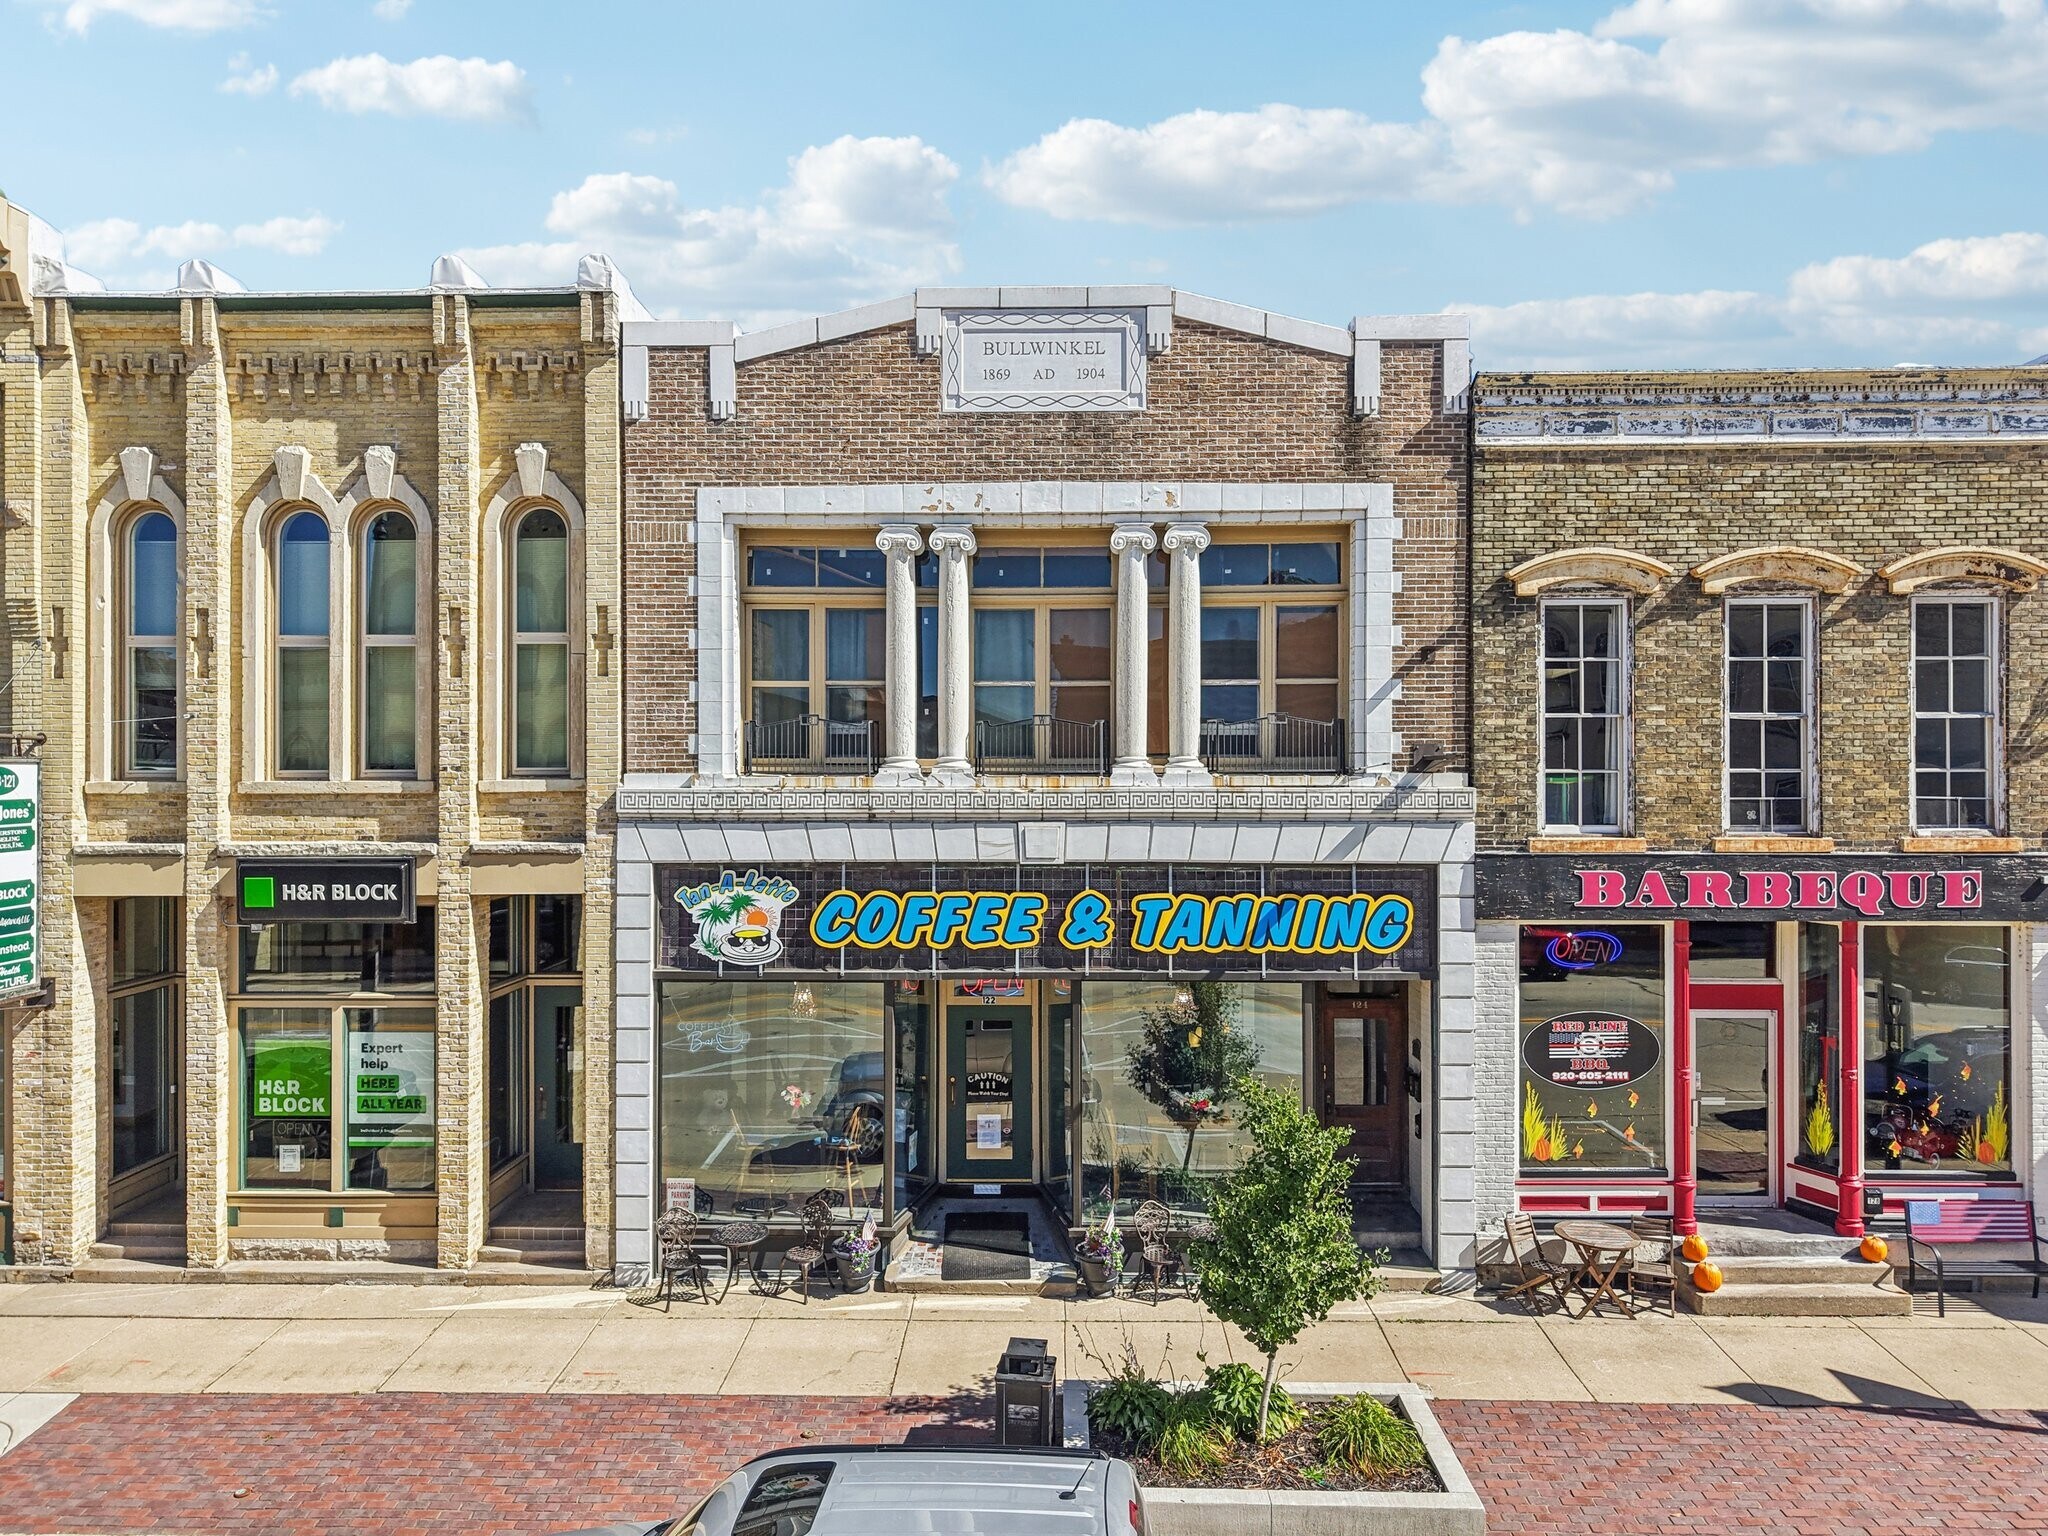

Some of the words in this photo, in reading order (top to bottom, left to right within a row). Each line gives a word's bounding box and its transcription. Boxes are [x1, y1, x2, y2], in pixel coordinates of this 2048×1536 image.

[983, 341, 1106, 356] BULLWINKEL
[983, 368, 1011, 381] 1869
[1033, 368, 1055, 380] AD
[1077, 368, 1105, 380] 1904
[282, 884, 326, 901] H&R
[331, 884, 398, 901] BLOCK
[677, 871, 798, 909] Tan-A-Latte
[1574, 870, 1983, 915] BARBEQUE
[811, 892, 1046, 947] COFFEE
[1062, 893, 1113, 946] &
[1134, 895, 1411, 952] TANNING
[1555, 937, 1611, 962] OPEN
[983, 996, 996, 1004] 122
[1551, 1021, 1585, 1032] RED
[1588, 1020, 1628, 1032] LINE
[361, 1043, 403, 1055] Expert
[361, 1058, 389, 1071] help
[1570, 1058, 1610, 1070] BBQ
[967, 1072, 1009, 1085] CAUTION
[1552, 1071, 1630, 1081] 920-605-2111
[258, 1079, 300, 1095] H&R
[361, 1078, 396, 1089] HERE
[258, 1097, 325, 1113] BLOCK
[361, 1099, 385, 1109] ALL
[388, 1099, 423, 1110] YEAR
